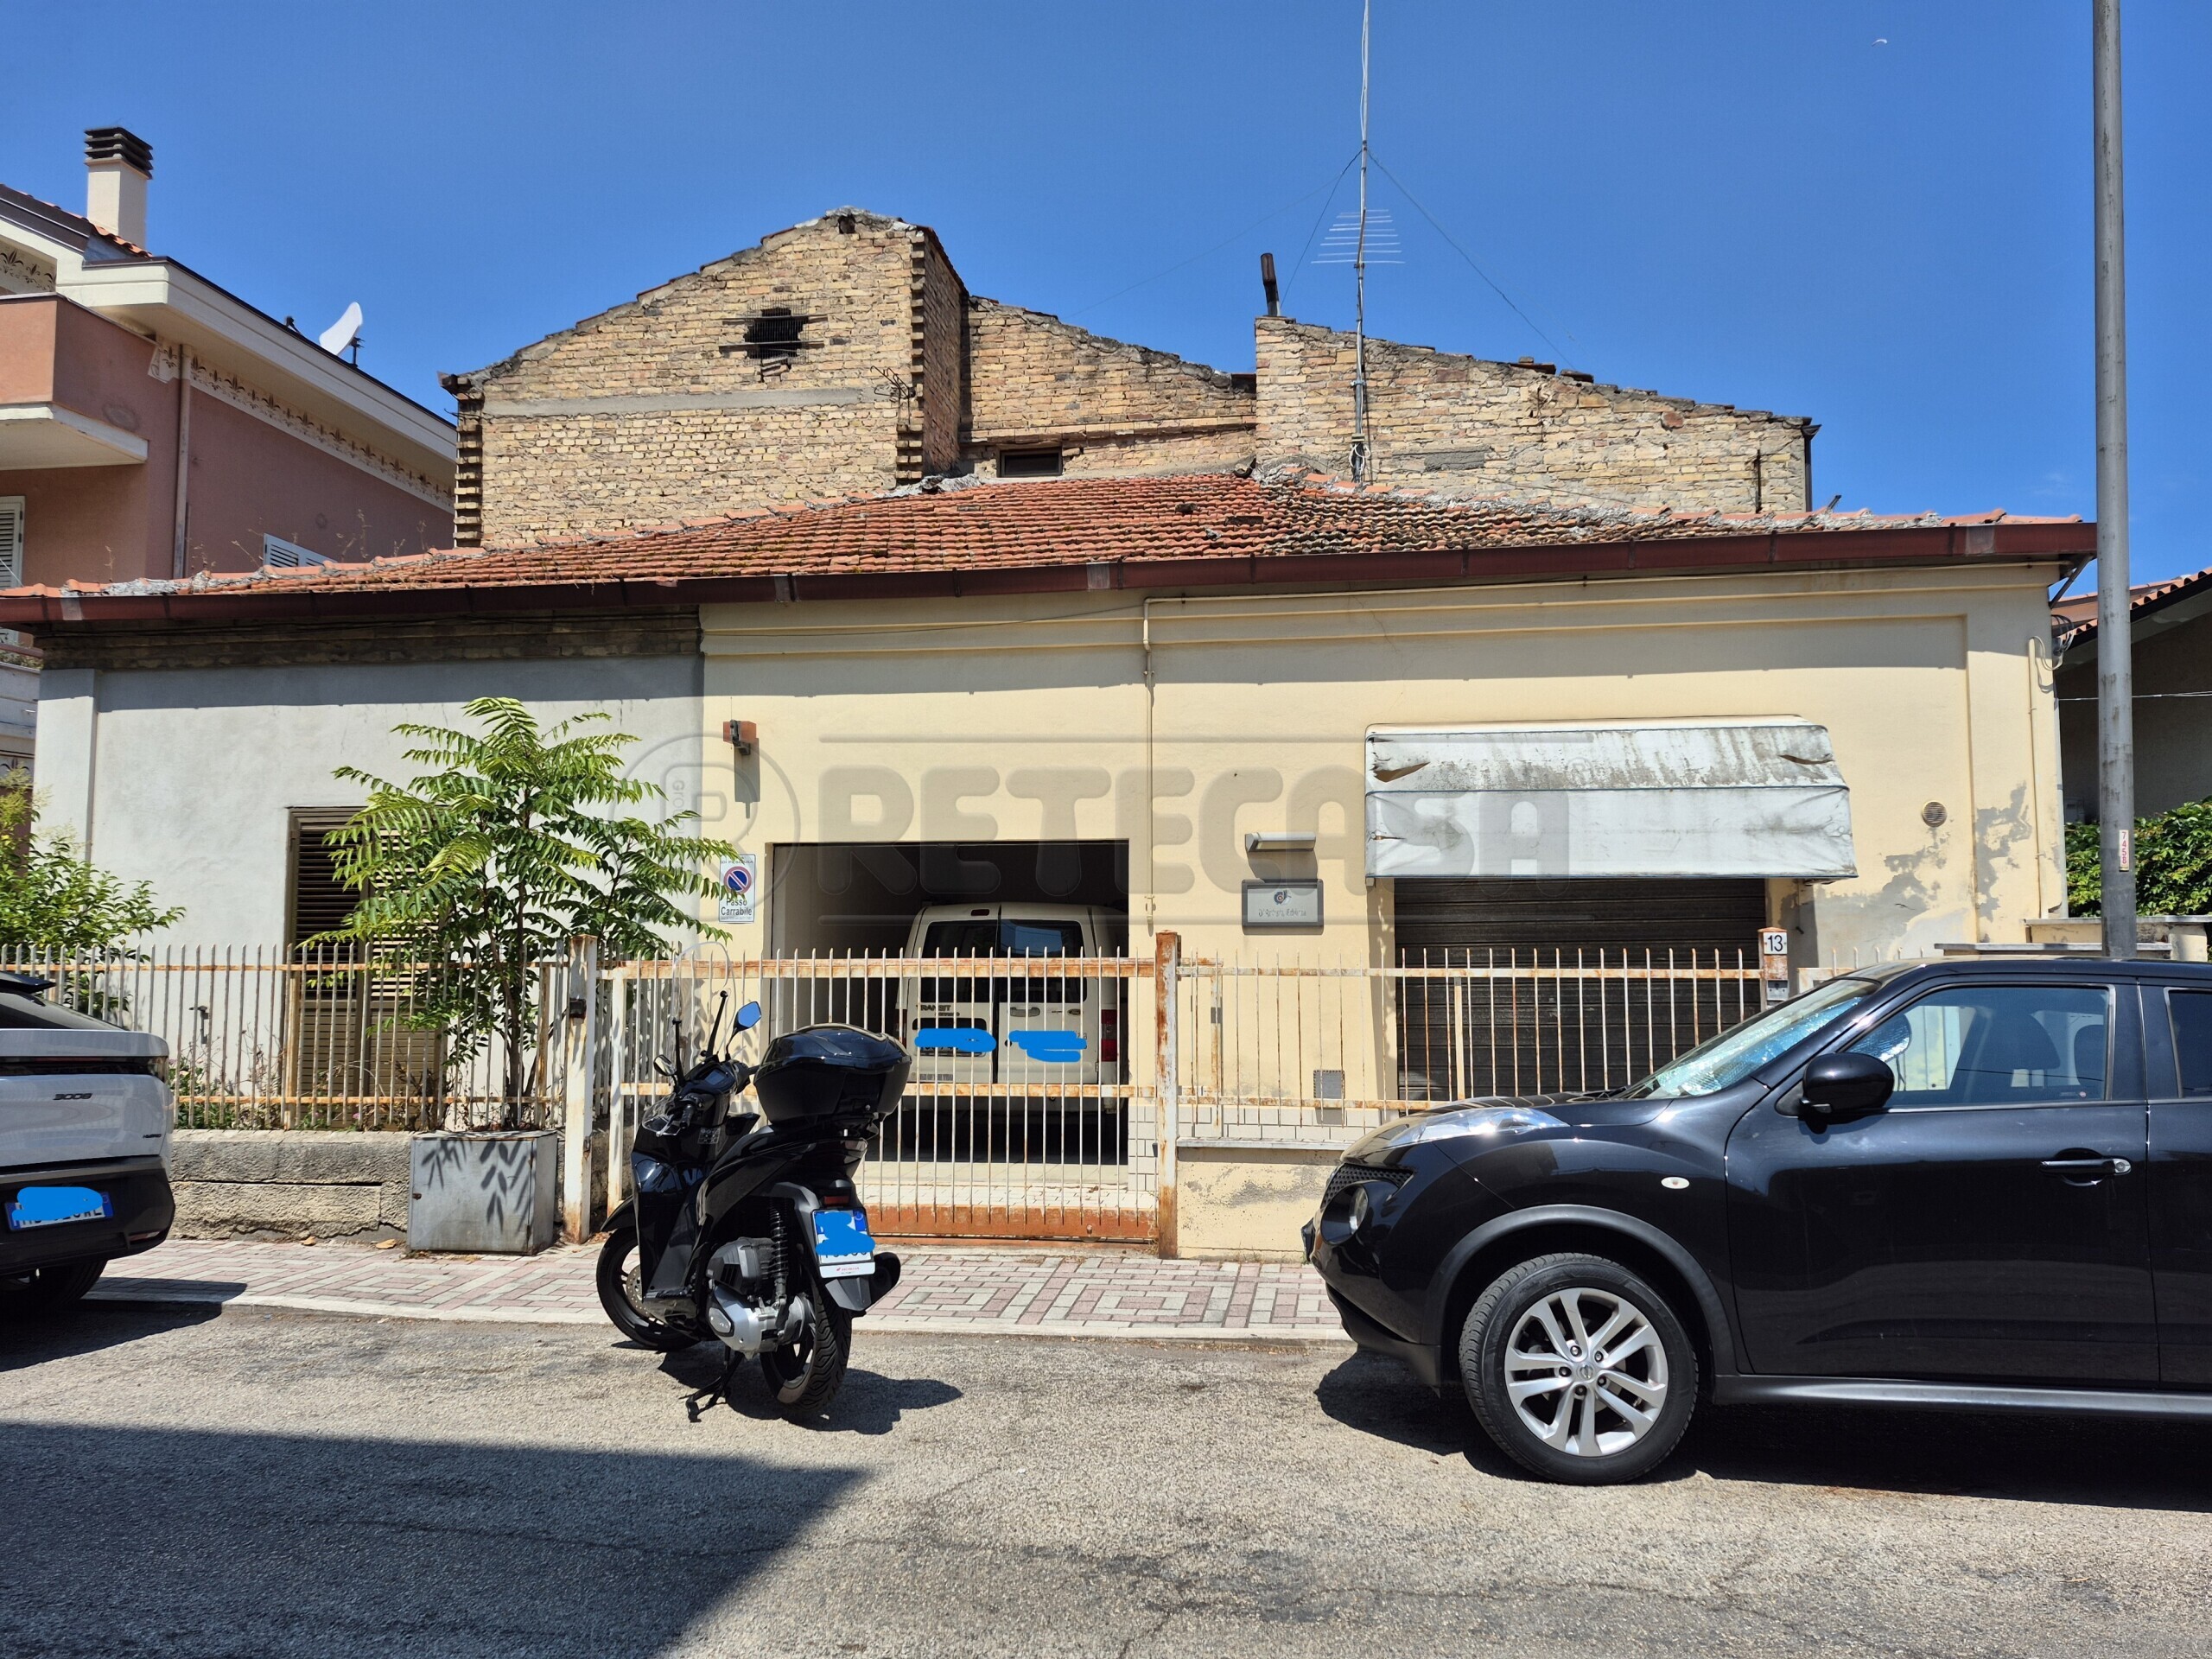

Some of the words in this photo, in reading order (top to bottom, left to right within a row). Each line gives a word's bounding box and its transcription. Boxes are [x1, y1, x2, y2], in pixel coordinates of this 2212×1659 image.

[727, 897, 747, 906] Passo
[721, 906, 752, 916] Carrabile
[1768, 935, 1783, 951] 13
